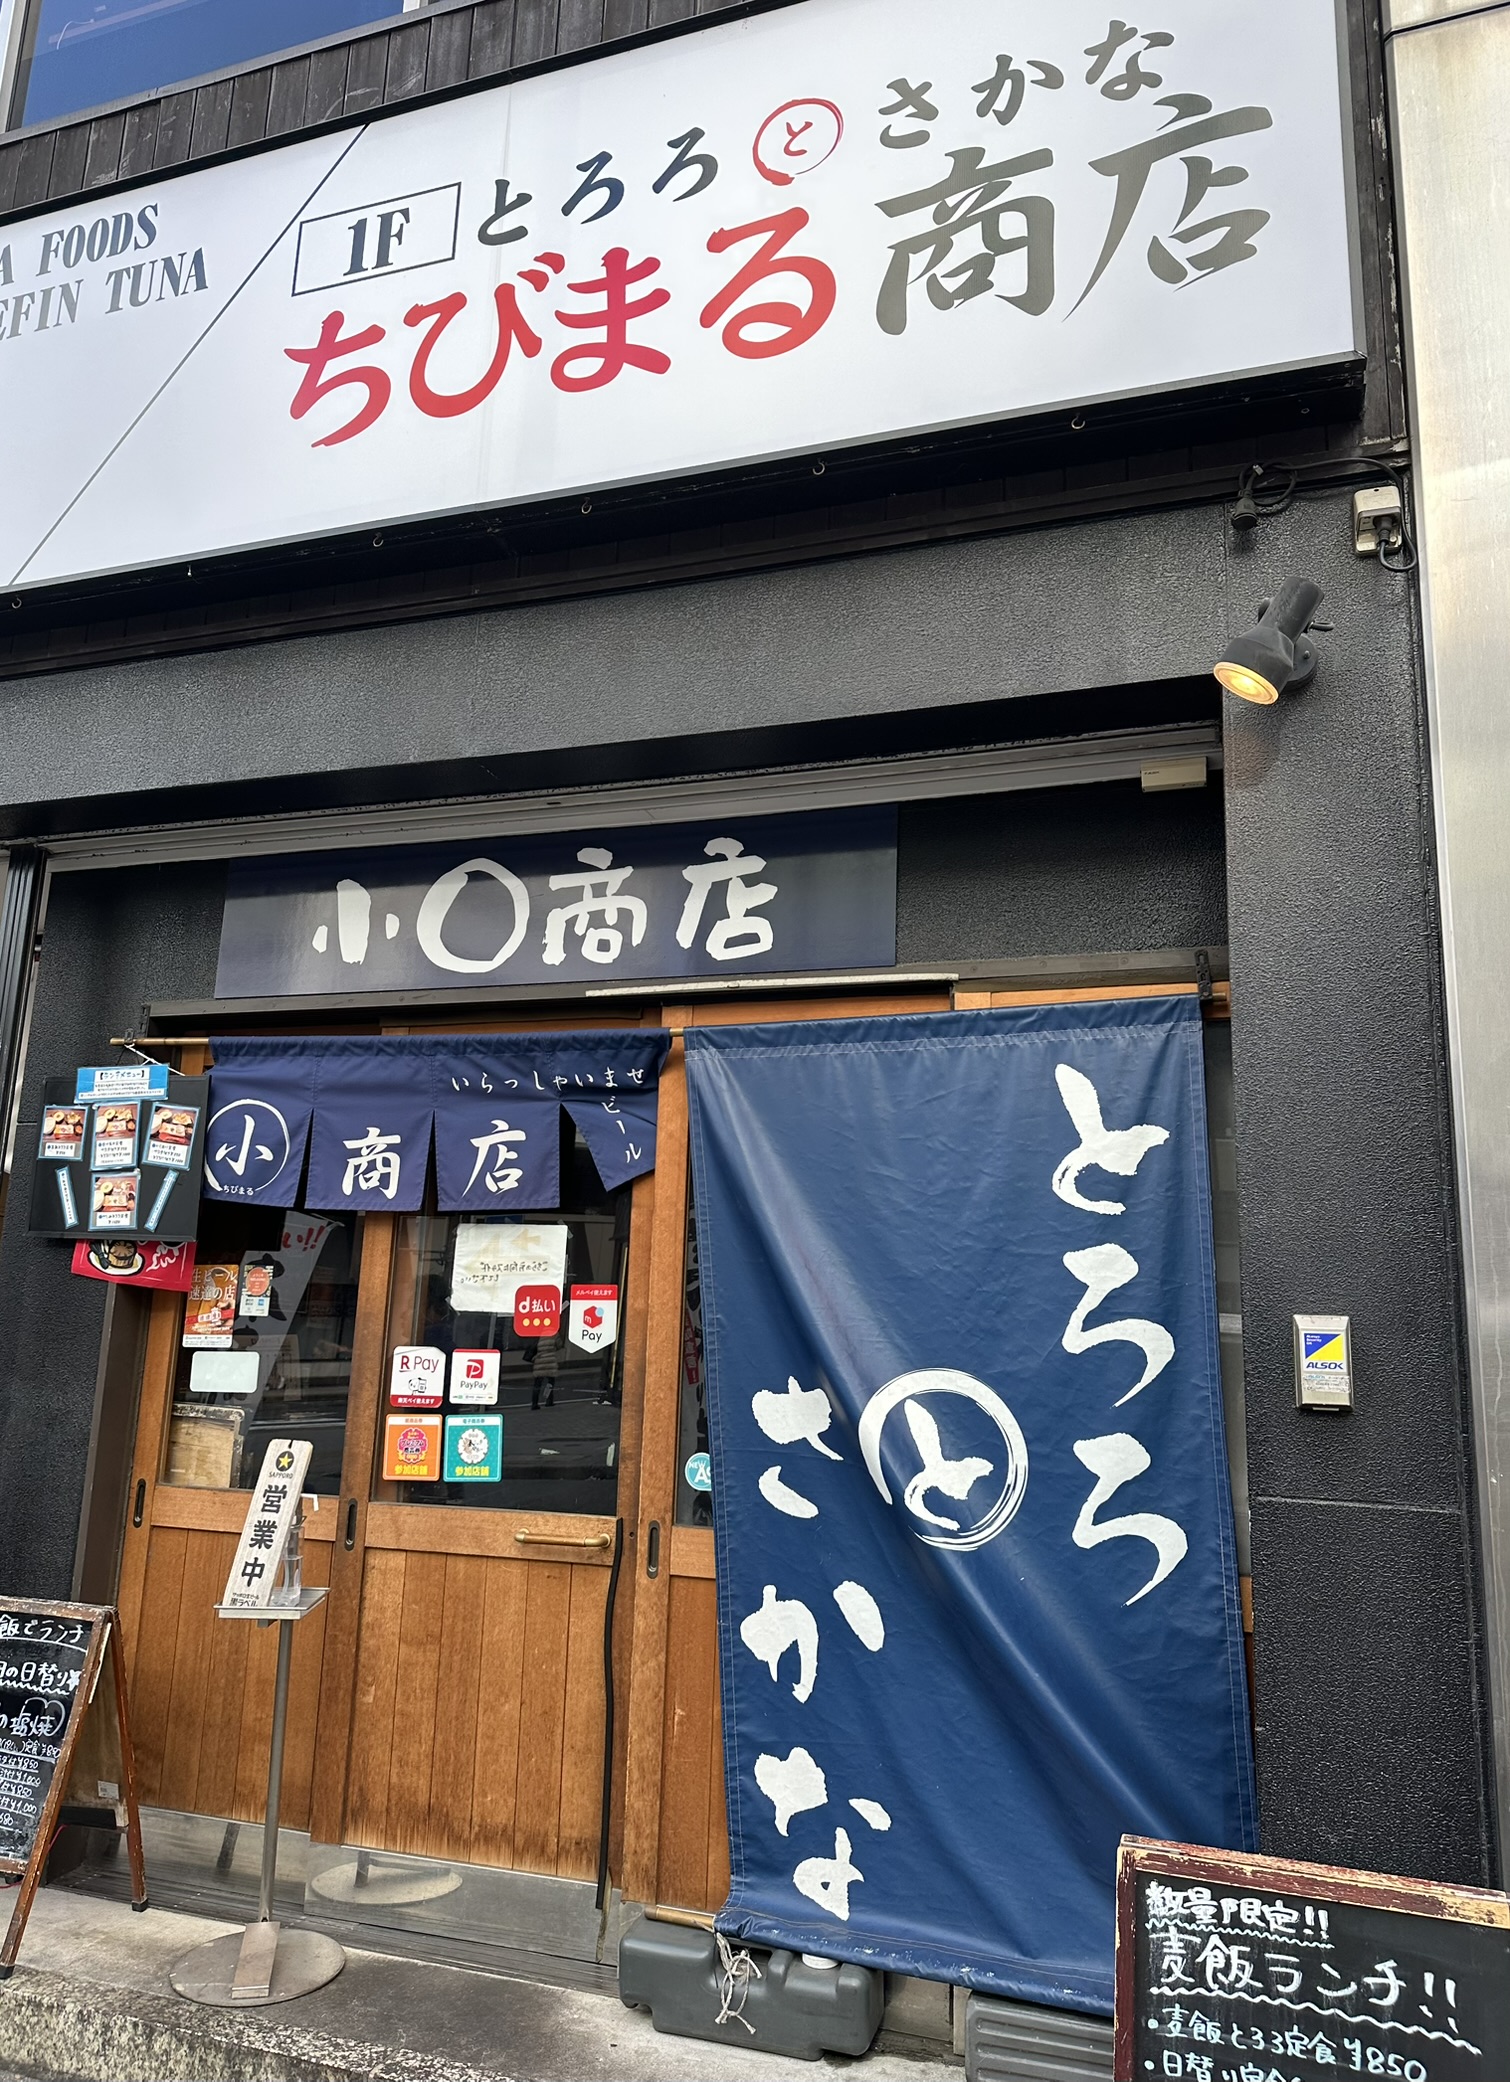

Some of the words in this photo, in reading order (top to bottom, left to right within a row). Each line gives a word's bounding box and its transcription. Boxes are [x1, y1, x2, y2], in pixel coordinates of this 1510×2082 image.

[343, 207, 411, 278] 1F
[478, 126, 719, 246] とろろ
[878, 19, 1175, 149] さかな
[36, 203, 159, 277] FOODS
[105, 247, 209, 314] TUNA
[452, 1066, 645, 1093] いらっしゃいませ
[602, 1096, 642, 1164] ビール
[223, 1184, 254, 1196] ちびまる
[581, 1329, 602, 1343] Pay
[1052, 1063, 1188, 1607] とろろ
[414, 1356, 439, 1373] Pay
[460, 1381, 488, 1390] PayPay
[1306, 1361, 1344, 1370] ALSOK
[241, 1484, 288, 1587] 営業中
[740, 1376, 892, 1920] さかな
[1343, 2038, 1427, 2082] ¥850
